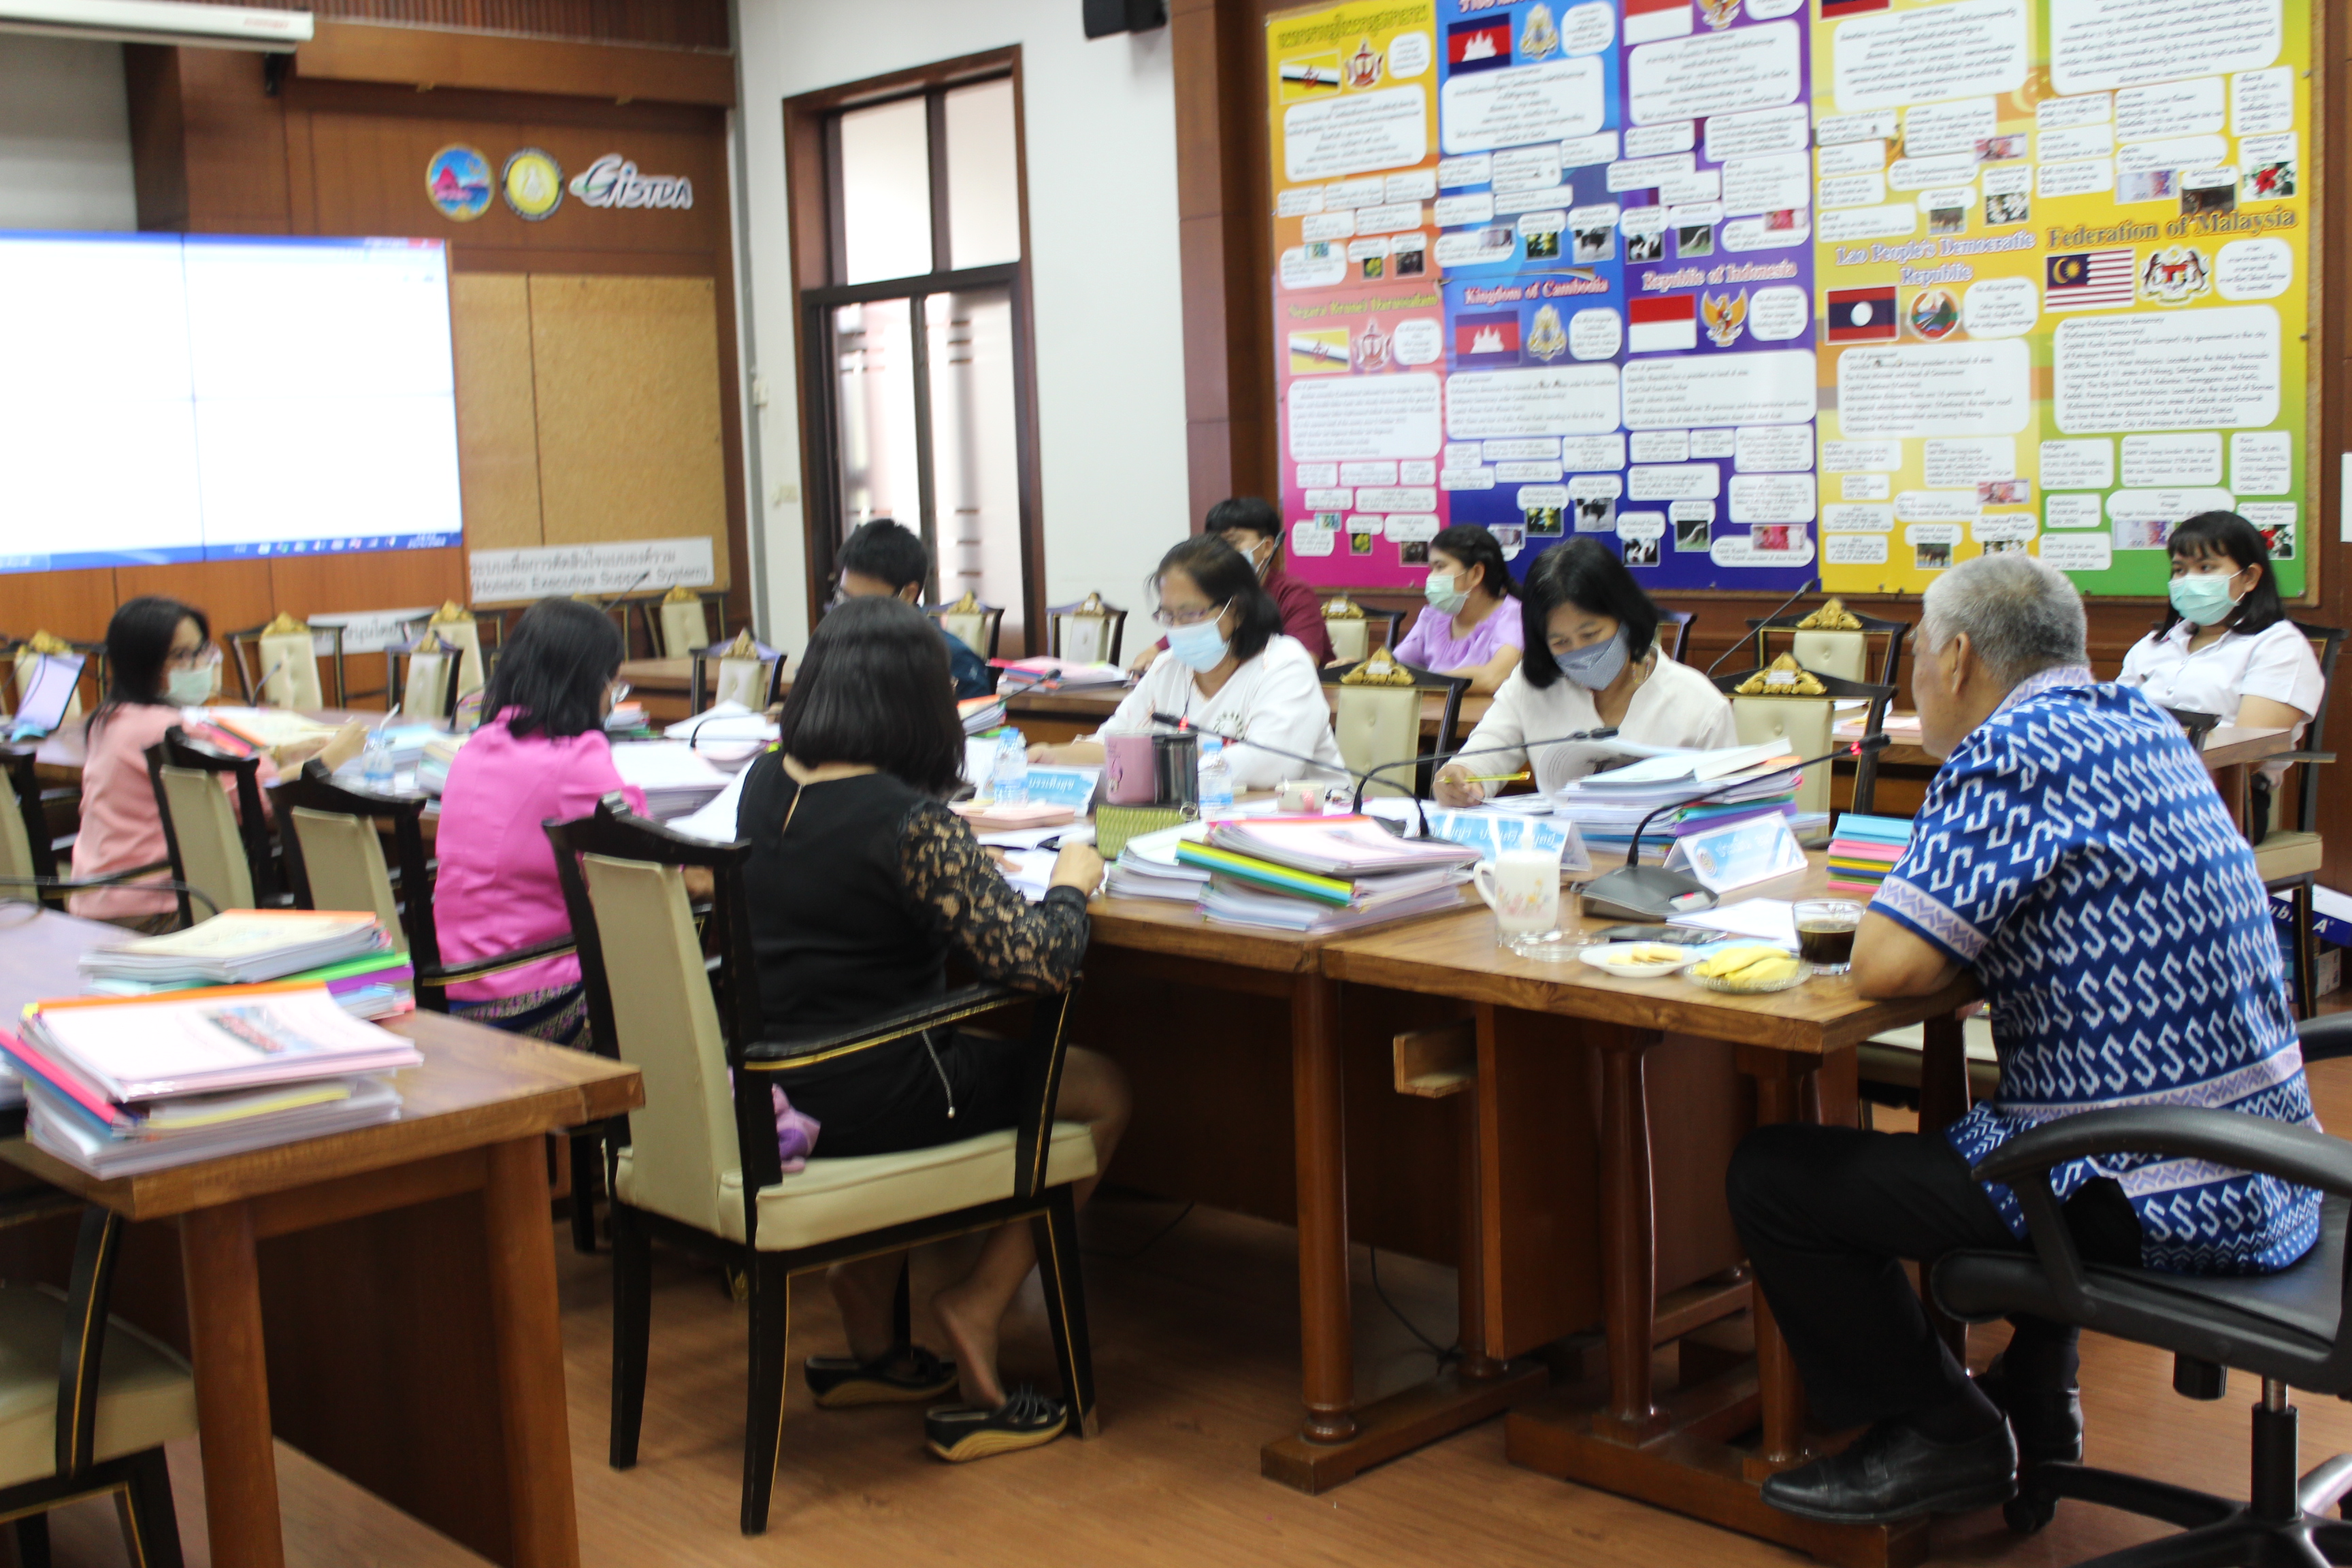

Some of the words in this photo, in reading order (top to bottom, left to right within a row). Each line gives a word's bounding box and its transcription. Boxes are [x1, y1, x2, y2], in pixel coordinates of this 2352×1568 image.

[2046, 219, 2158, 249] Federation
[2167, 214, 2188, 238] of
[2189, 206, 2296, 236] Malaysia
[1836, 246, 1868, 265] Lao
[1872, 240, 1936, 263] People's
[1940, 231, 2036, 257] Democratic
[1464, 284, 1521, 306] Kingdom
[1524, 283, 1539, 299] of
[1542, 276, 1608, 299] Cambodia
[1642, 267, 1705, 293] Republic
[1707, 264, 1724, 284] of
[1725, 259, 1797, 282] Indonesia
[1901, 262, 1974, 288] Republic
